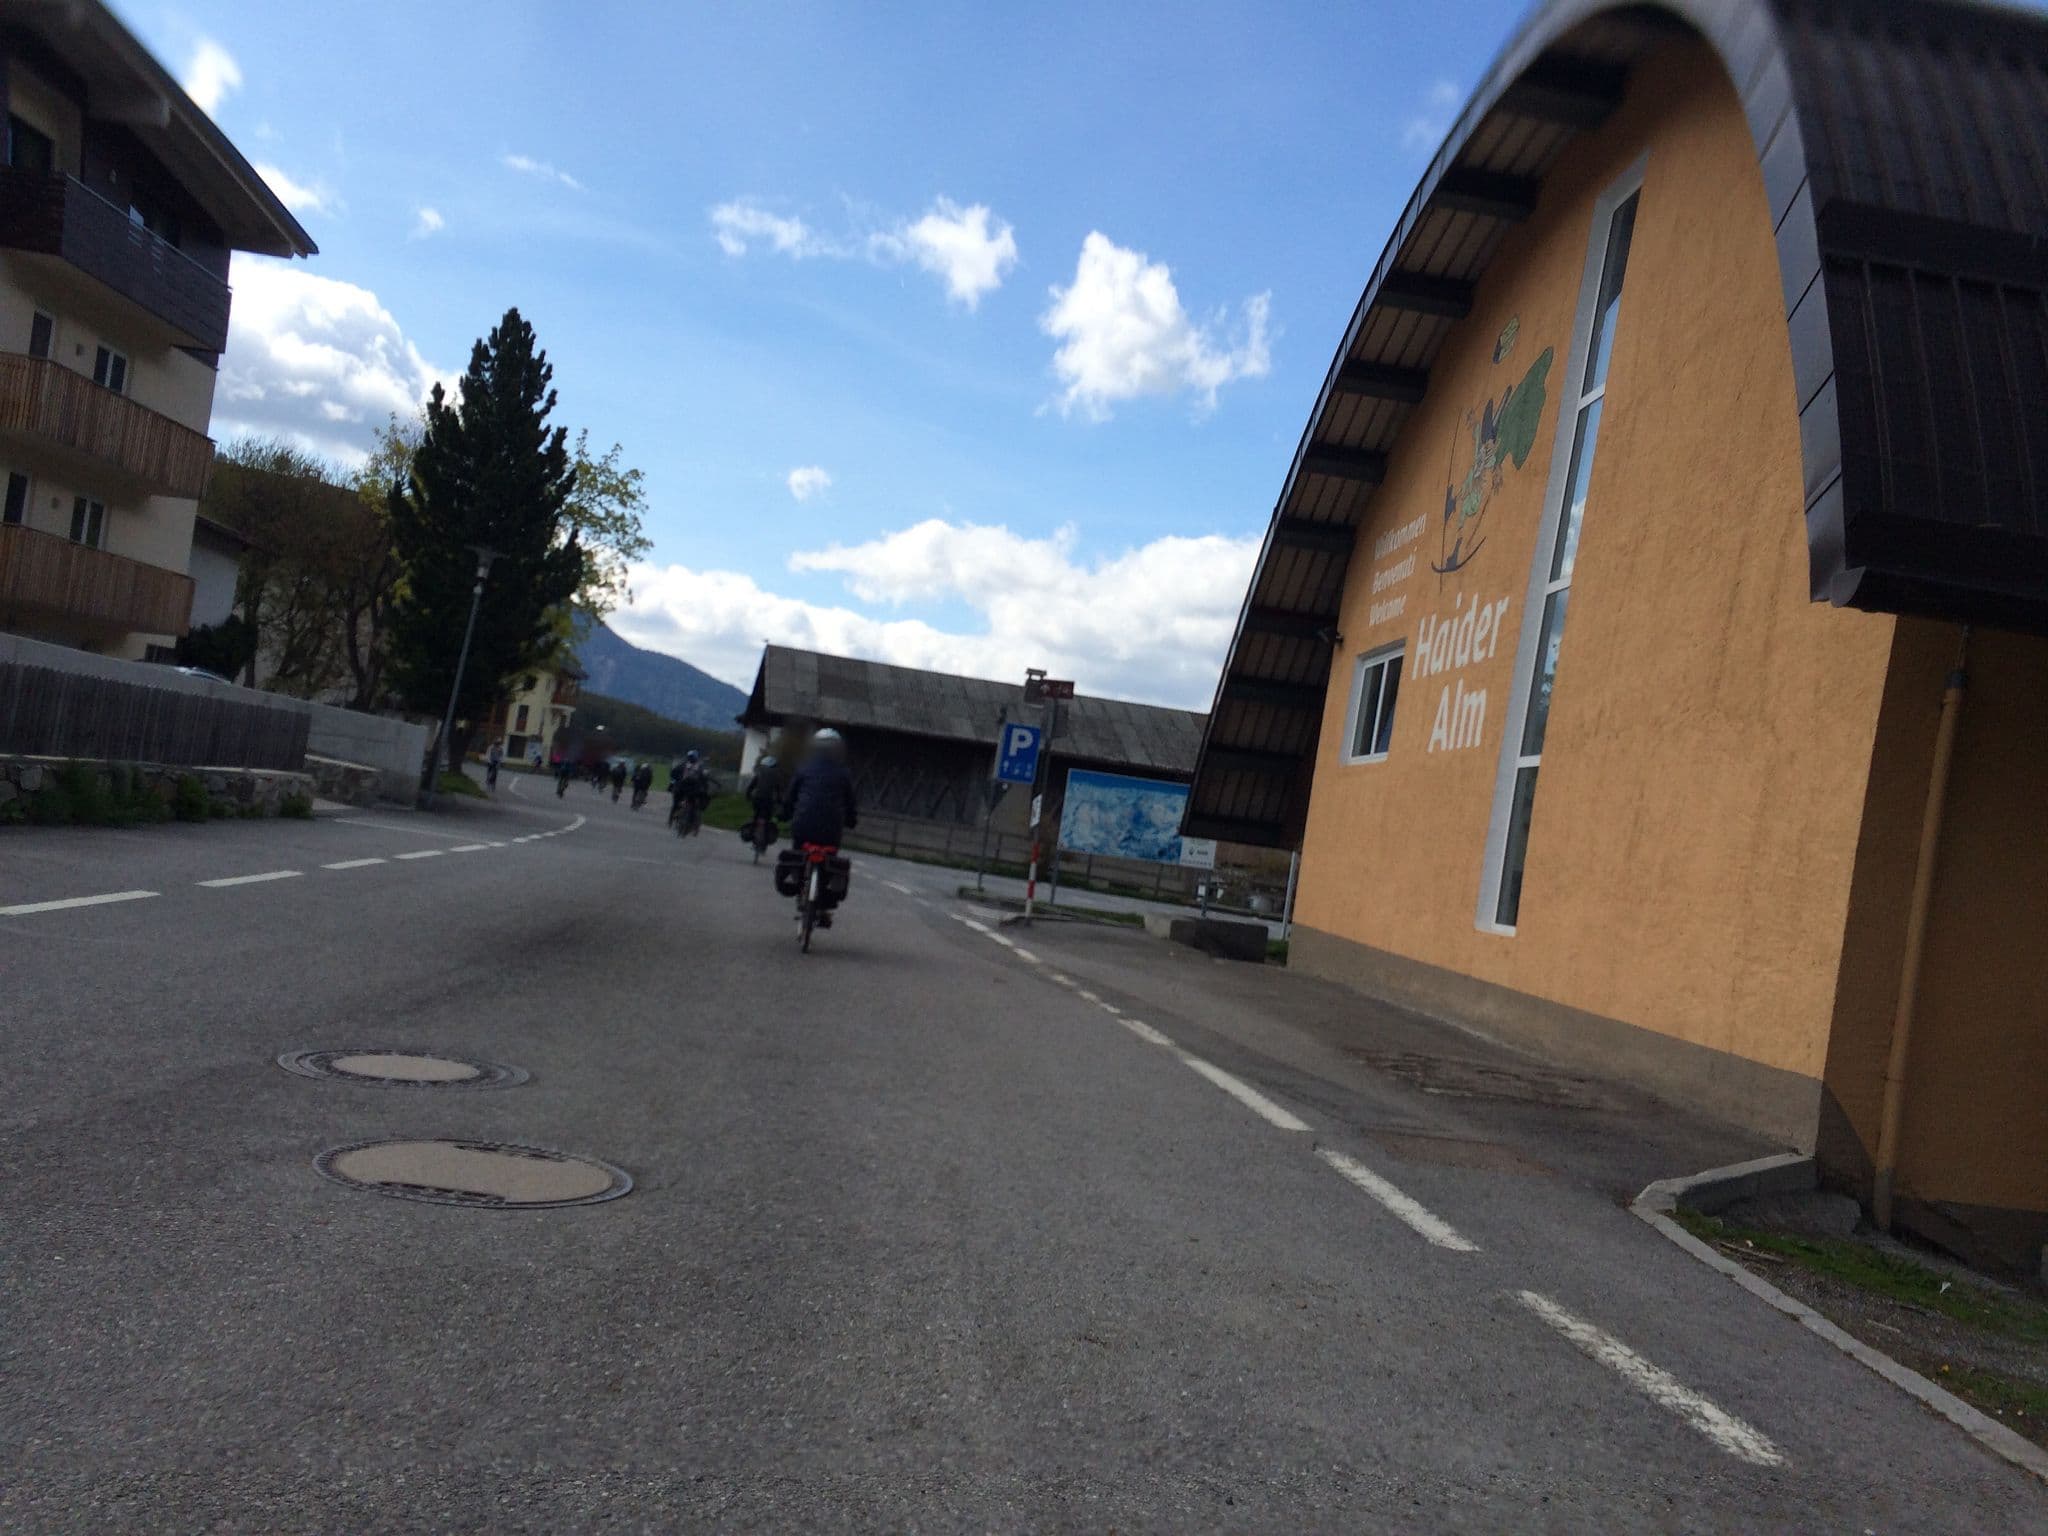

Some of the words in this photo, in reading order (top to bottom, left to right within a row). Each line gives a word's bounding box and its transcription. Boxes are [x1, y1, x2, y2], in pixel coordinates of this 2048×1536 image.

[1411, 592, 1510, 680] Haider
[1009, 727, 1034, 756] P
[1427, 679, 1487, 753] Alm
